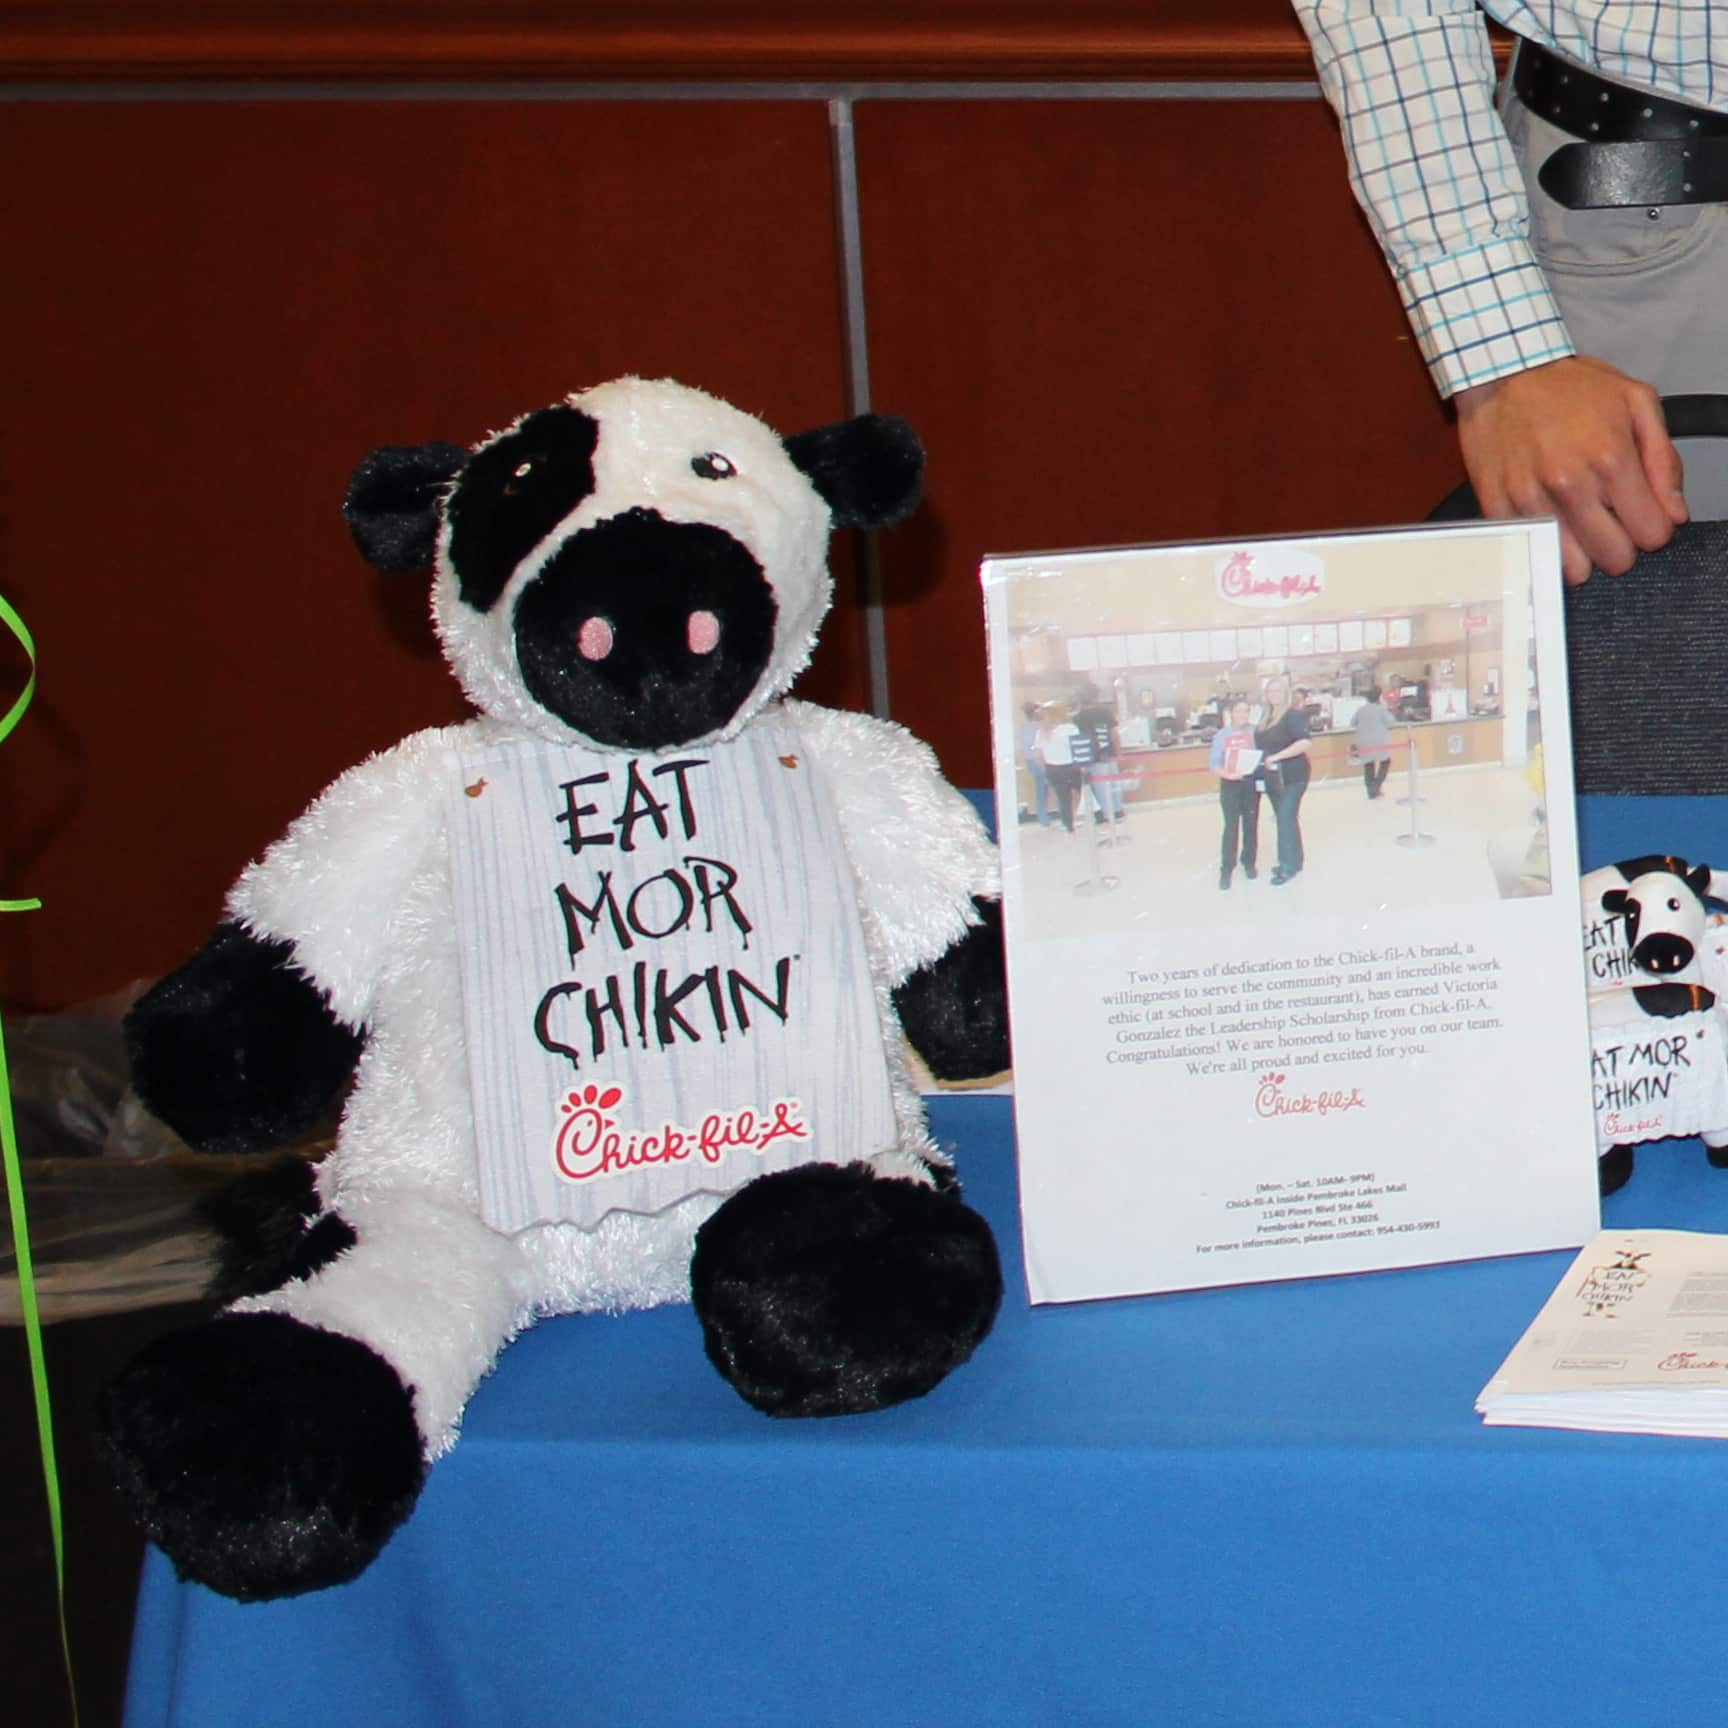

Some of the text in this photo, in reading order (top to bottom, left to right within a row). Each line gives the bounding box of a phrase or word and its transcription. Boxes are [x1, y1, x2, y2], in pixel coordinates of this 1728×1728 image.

[555, 759, 710, 855] EAT
[554, 856, 753, 971] MOR
[1101, 957, 1502, 1006] willingness to serve the community and an incredible work
[1127, 941, 1474, 985] Two years of dedication to the Chick-fil-A brand, a
[534, 956, 790, 1070] CHIKIN
[1107, 977, 1498, 1025] ethic (at school and in the restaurant), has earned Victoria
[1115, 997, 1492, 1044] Gonzalez the Leadership Scholarship from Chick-fil-A.
[1105, 1018, 1504, 1065] Congratulations! We are honored to have you on our team.
[1185, 1044, 1427, 1076] We're all proud and excited for you.
[1592, 1046, 1623, 1077] AT
[1255, 1072, 1366, 1119] Chick-fil-A
[555, 1084, 807, 1180] Chick-fil-A
